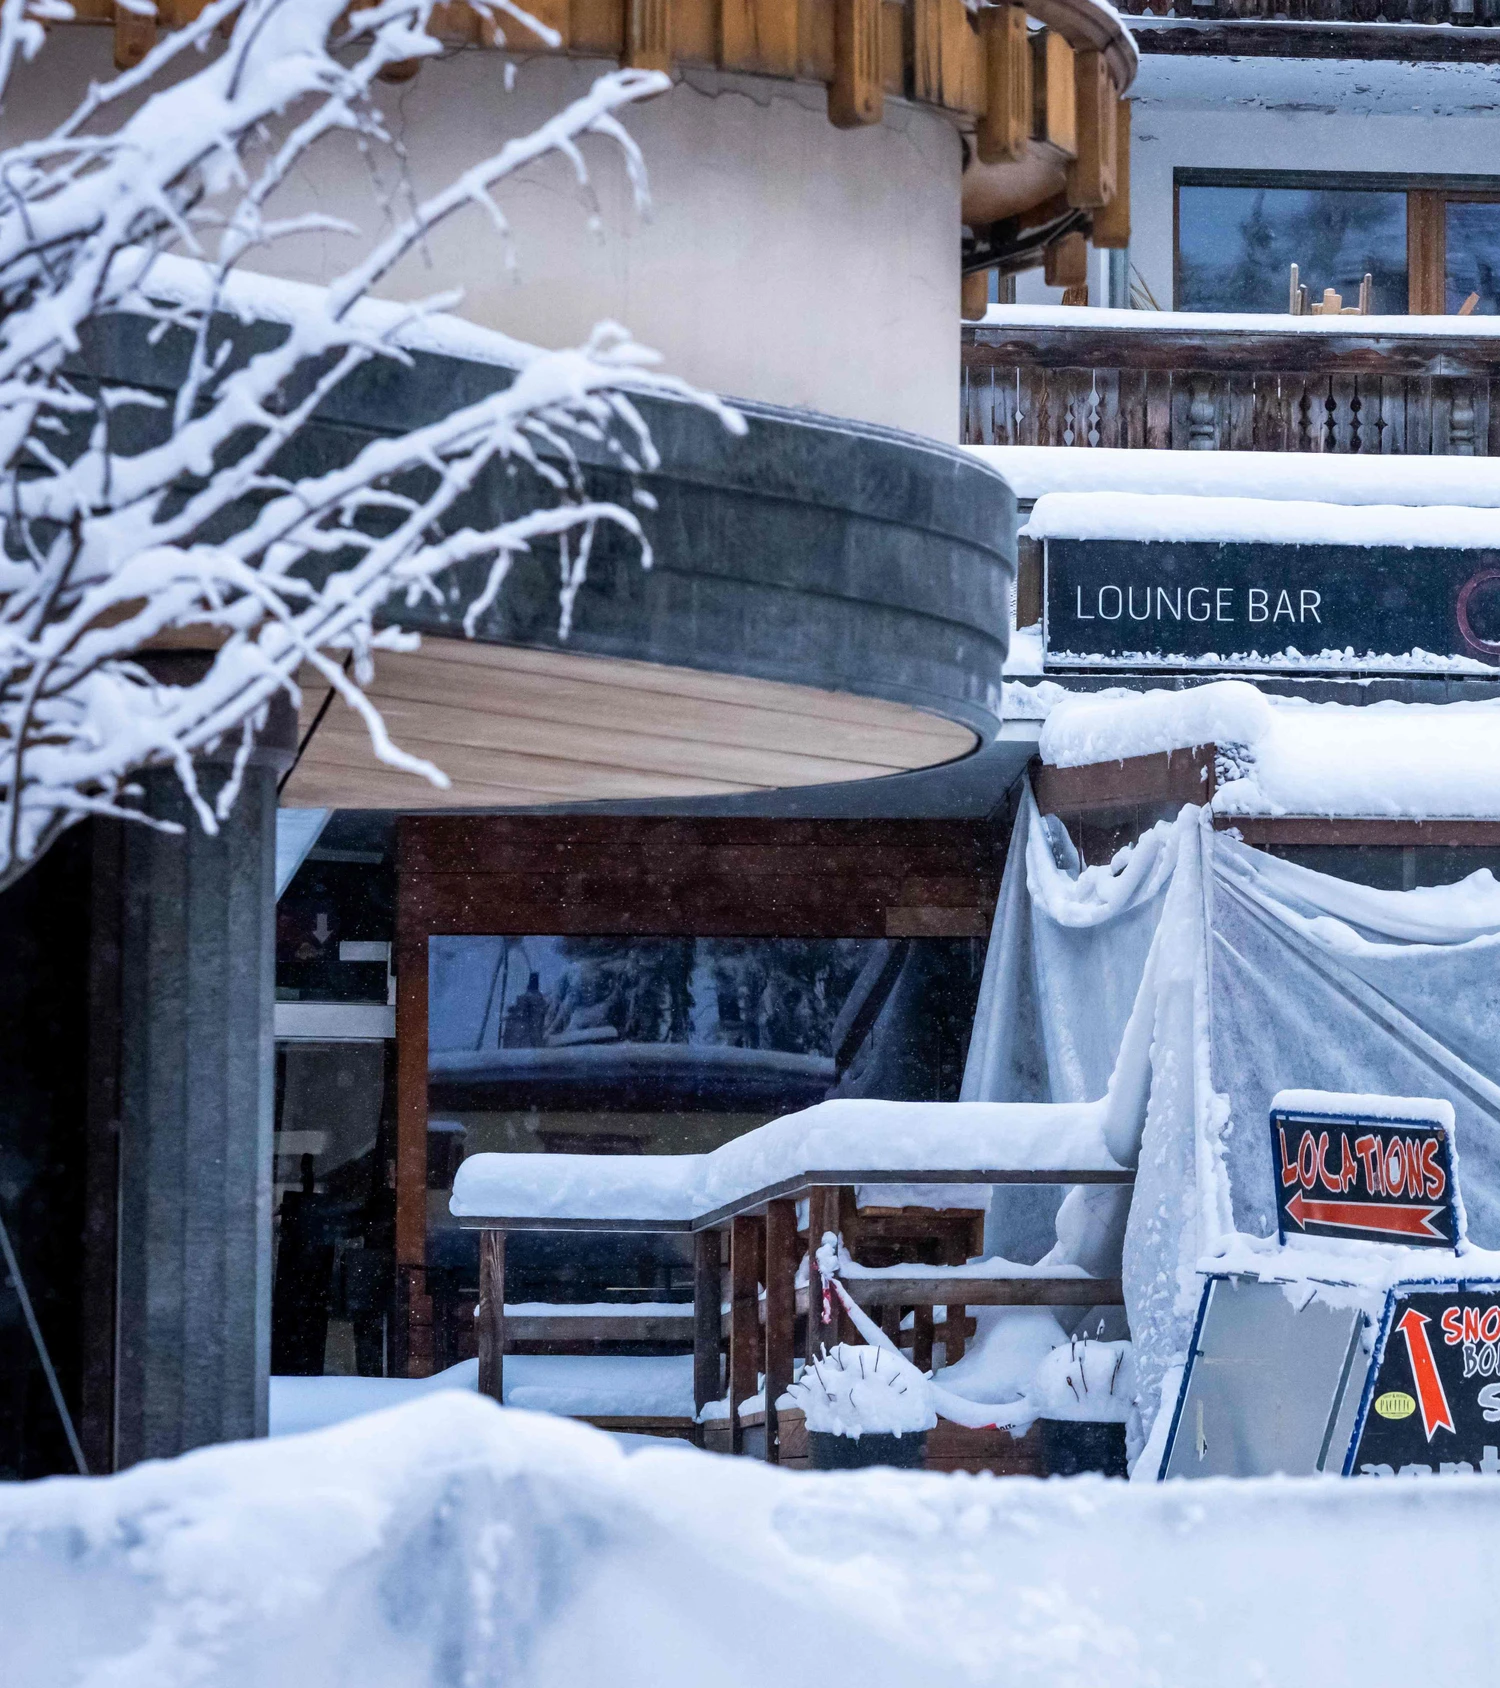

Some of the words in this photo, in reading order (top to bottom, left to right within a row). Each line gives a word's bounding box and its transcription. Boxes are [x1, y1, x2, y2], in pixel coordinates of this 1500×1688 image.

[1077, 585, 1235, 622] LOUNGE
[1248, 588, 1322, 623] BAR
[1279, 1127, 1447, 1201] LOCATIONS
